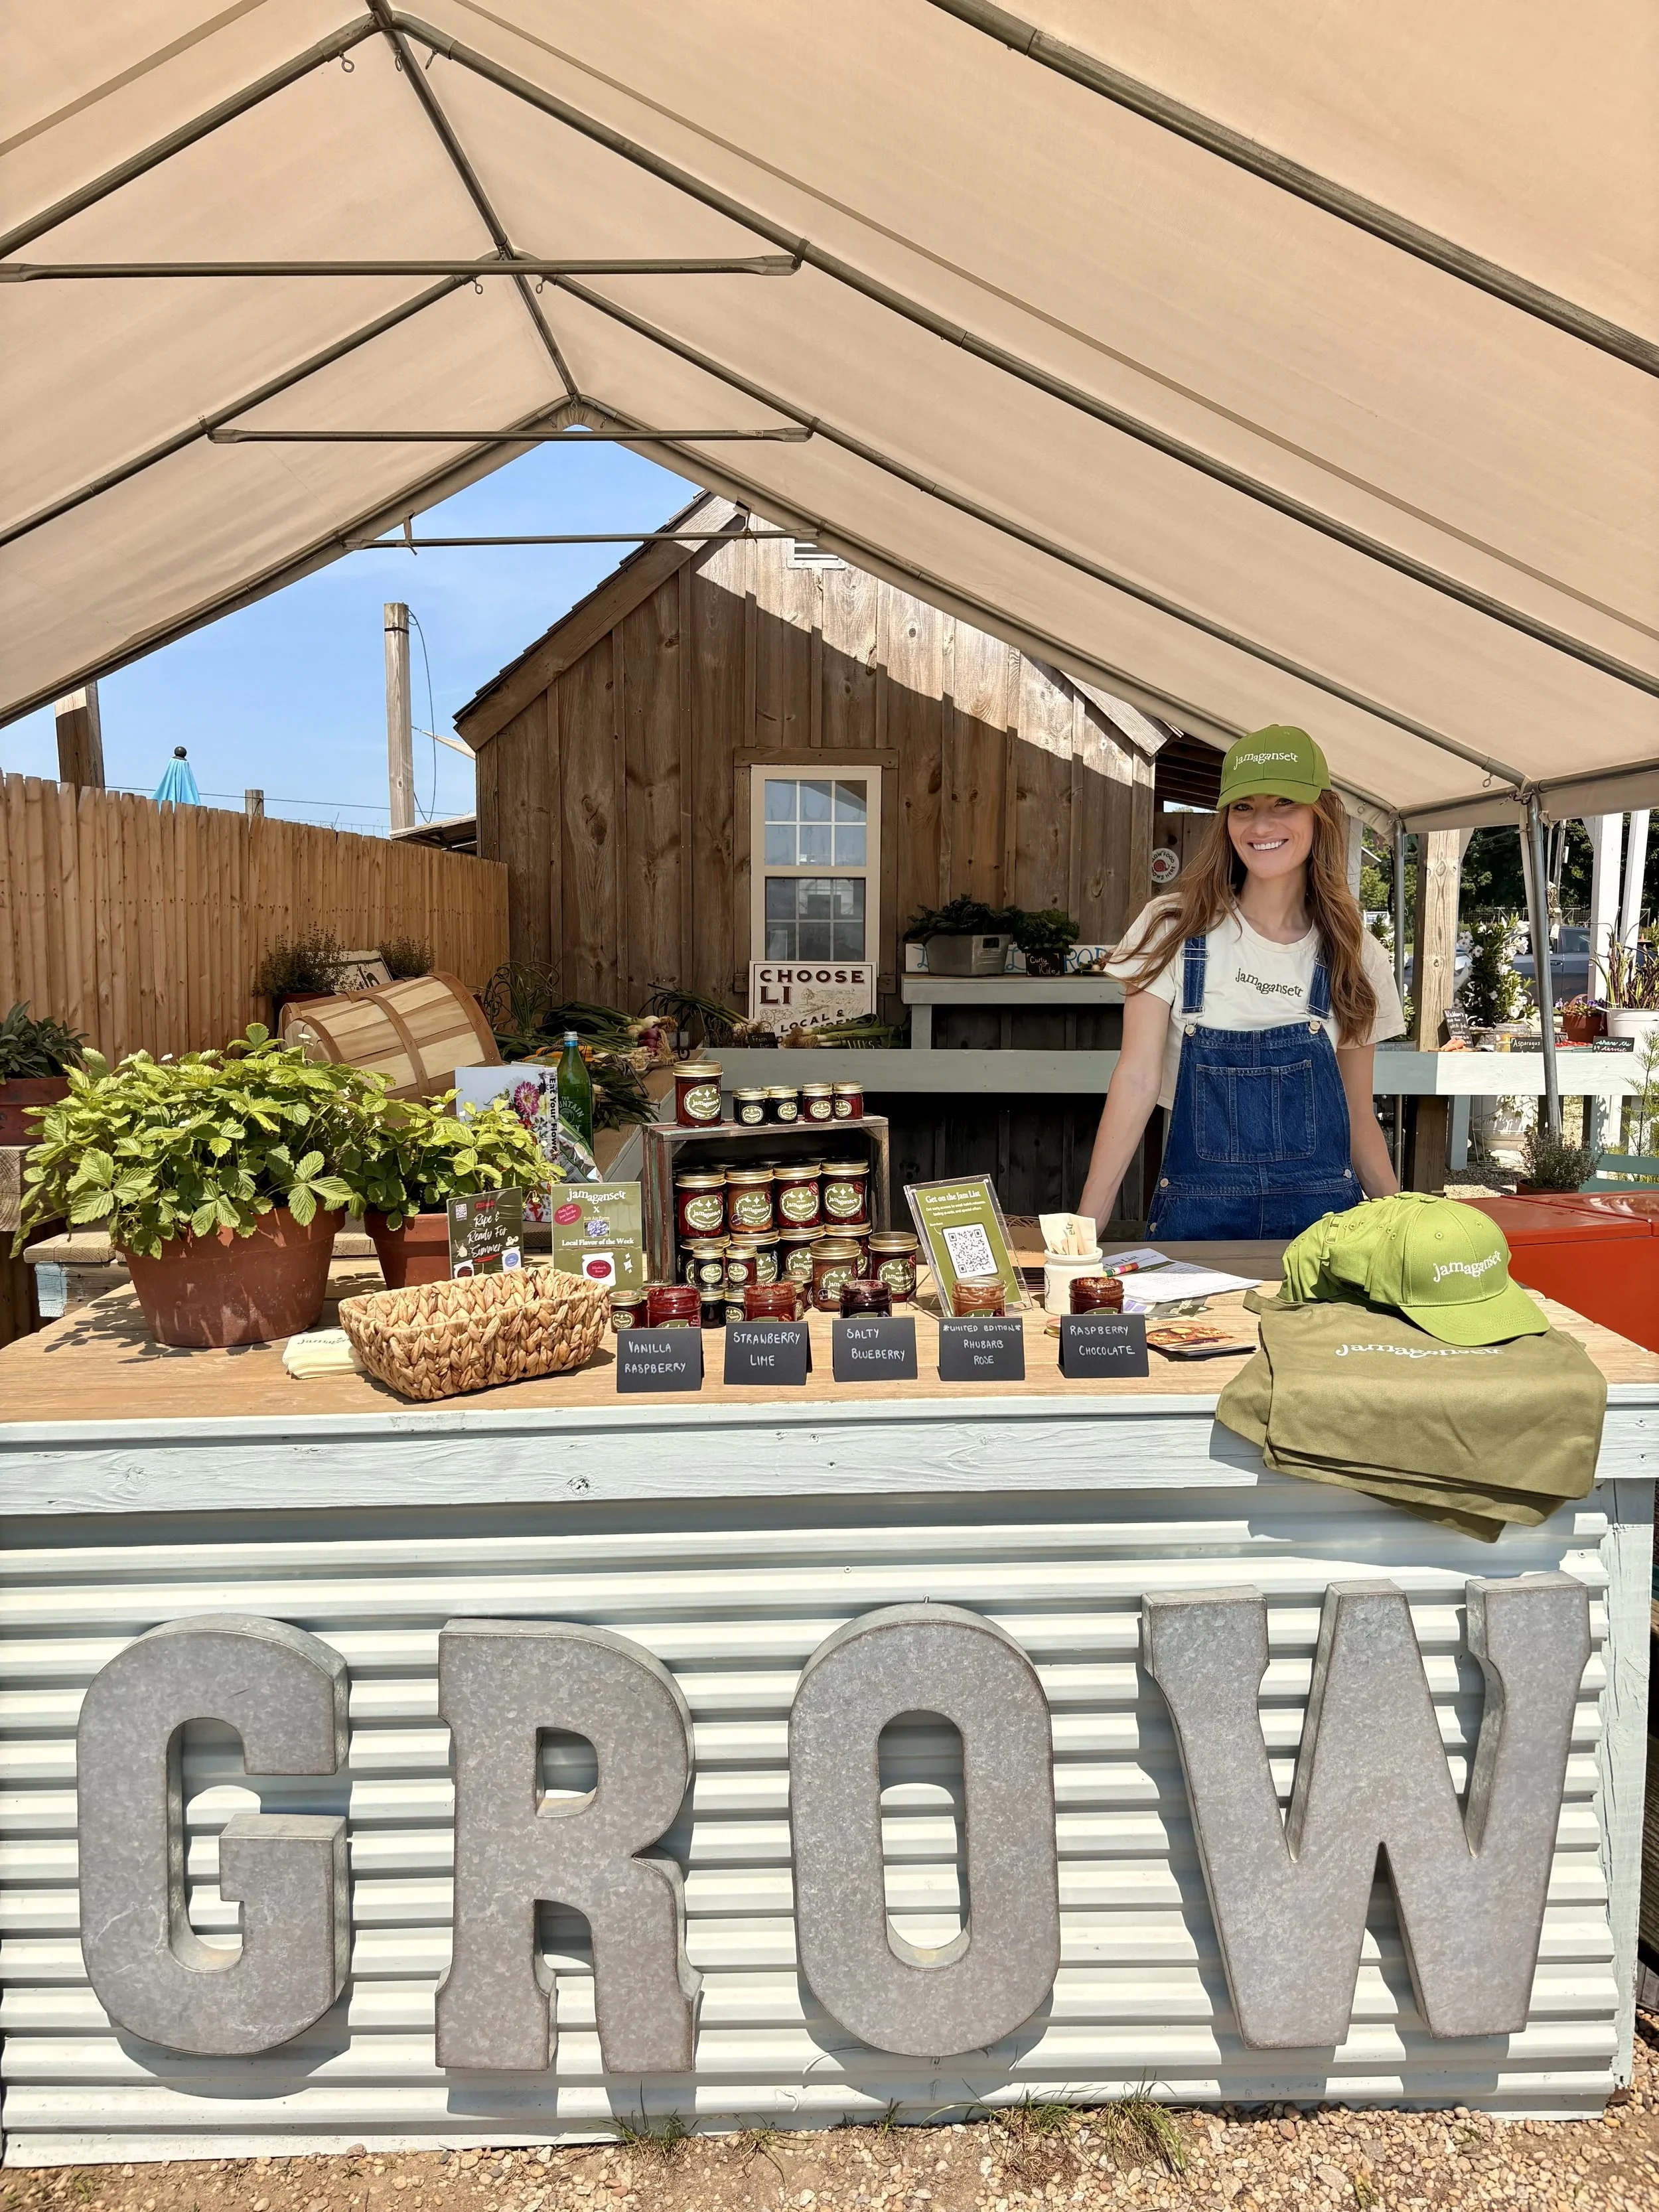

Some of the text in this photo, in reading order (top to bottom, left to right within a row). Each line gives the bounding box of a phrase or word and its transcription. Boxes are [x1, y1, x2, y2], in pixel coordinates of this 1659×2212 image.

[1151, 852, 1163, 862] LOW
[1165, 866, 1175, 878] HERE
[1030, 956, 1048, 967] Curly
[759, 969, 865, 984] CHOOSE
[1235, 968, 1304, 997] jamagansett
[759, 986, 793, 1005] LI
[780, 1013, 830, 1033] LOCAL
[836, 1009, 845, 1017] &
[1513, 1039, 1540, 1049] Asparagus
[566, 1188, 626, 1205] jamagansett
[956, 1192, 969, 1201] Jam
[473, 1213, 492, 1228] Ripe
[467, 1224, 508, 1244] Ready For
[470, 1242, 503, 1258] Summer
[1433, 1250, 1502, 1283] jamagansett
[846, 1328, 880, 1339] SALTY
[1070, 1325, 1129, 1336] RASPBERRY
[733, 1331, 801, 1345] STRAWBERRY
[964, 1339, 1004, 1349] RHUBARB
[628, 1341, 672, 1353] VANILLA
[1078, 1345, 1136, 1356] CHOCOLATE
[750, 1354, 776, 1366] LIME
[851, 1347, 906, 1361] BLUEBERRY
[973, 1355, 995, 1365] ROSE
[624, 1362, 686, 1374] RASPBERRY
[78, 1576, 1591, 2075] GROW
